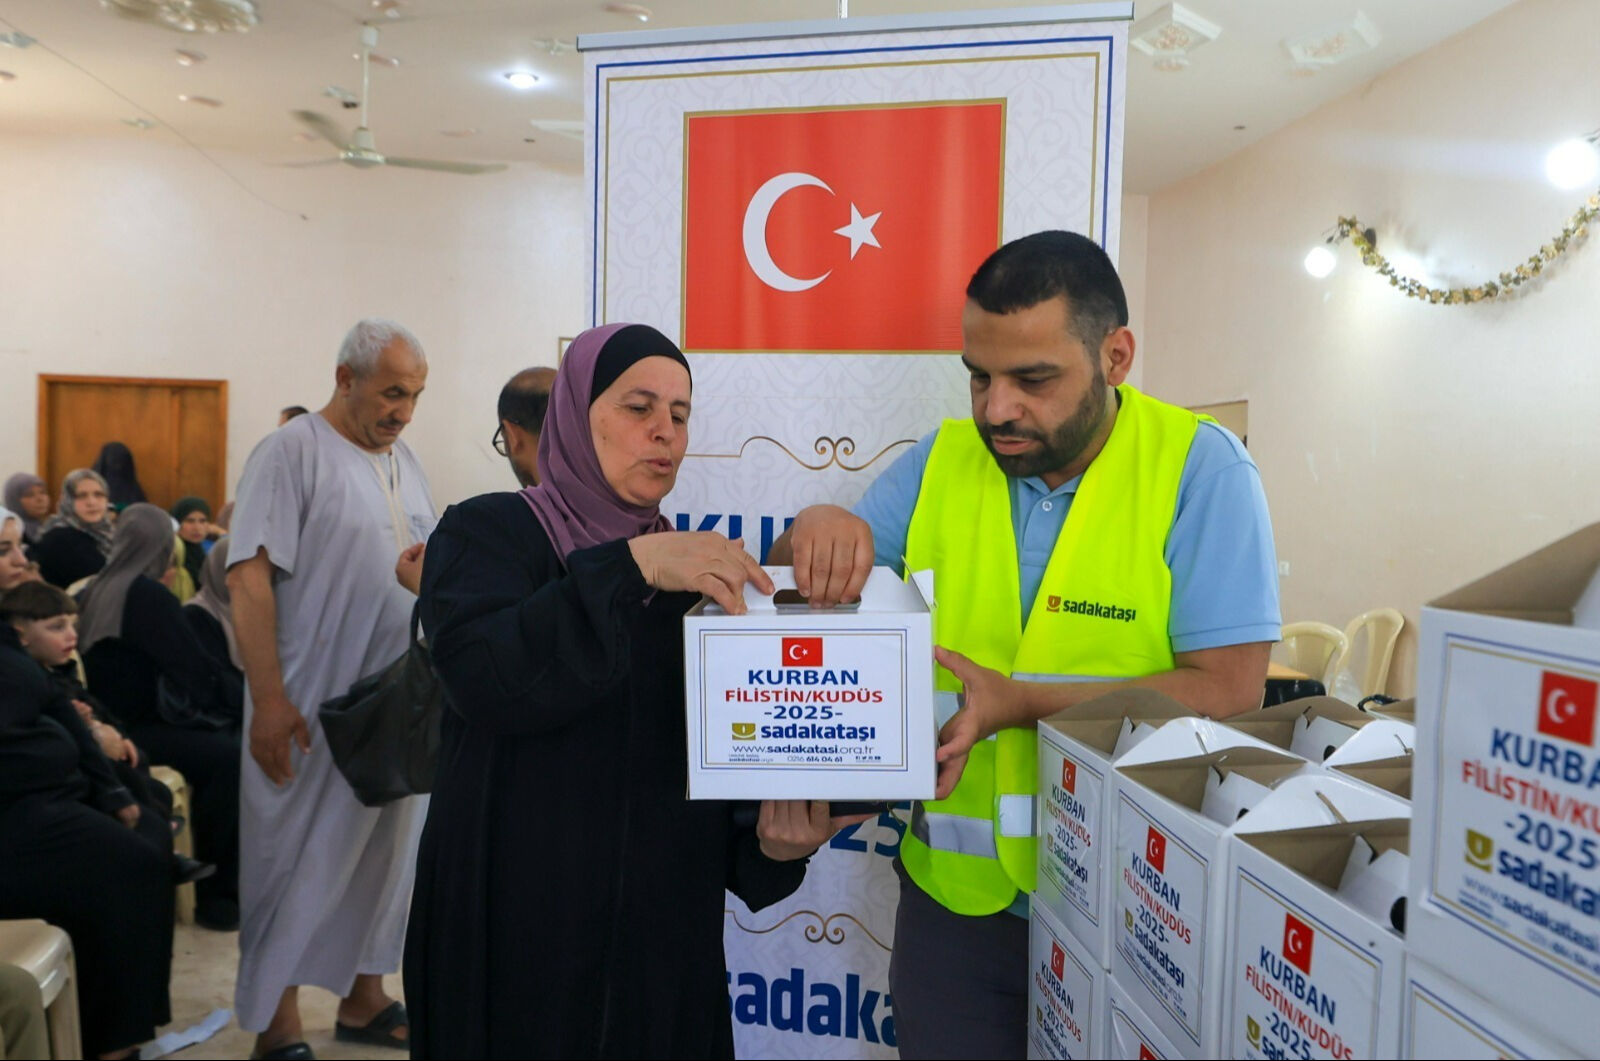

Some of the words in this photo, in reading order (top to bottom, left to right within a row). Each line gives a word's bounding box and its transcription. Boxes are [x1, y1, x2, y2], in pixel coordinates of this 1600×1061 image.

[1063, 599, 1136, 622] sadakataşı
[725, 688, 883, 703] FİLİSTİN/KUDÜS
[748, 669, 859, 686] KURBAN
[764, 705, 843, 720] -2025-
[732, 744, 874, 755] www.sadakatasi.org.tr
[761, 723, 876, 742] sadakataşı
[1052, 783, 1086, 822] KURBAN
[1132, 852, 1180, 912] KURBAN
[1124, 868, 1191, 945] FİLİSTİN/KUDÜS
[1136, 904, 1170, 944] -2025-
[1134, 922, 1185, 989] sadakataşı
[1041, 960, 1074, 1015] KURBAN
[1260, 945, 1336, 1026] KURBAN
[1266, 1011, 1316, 1060] -2025
